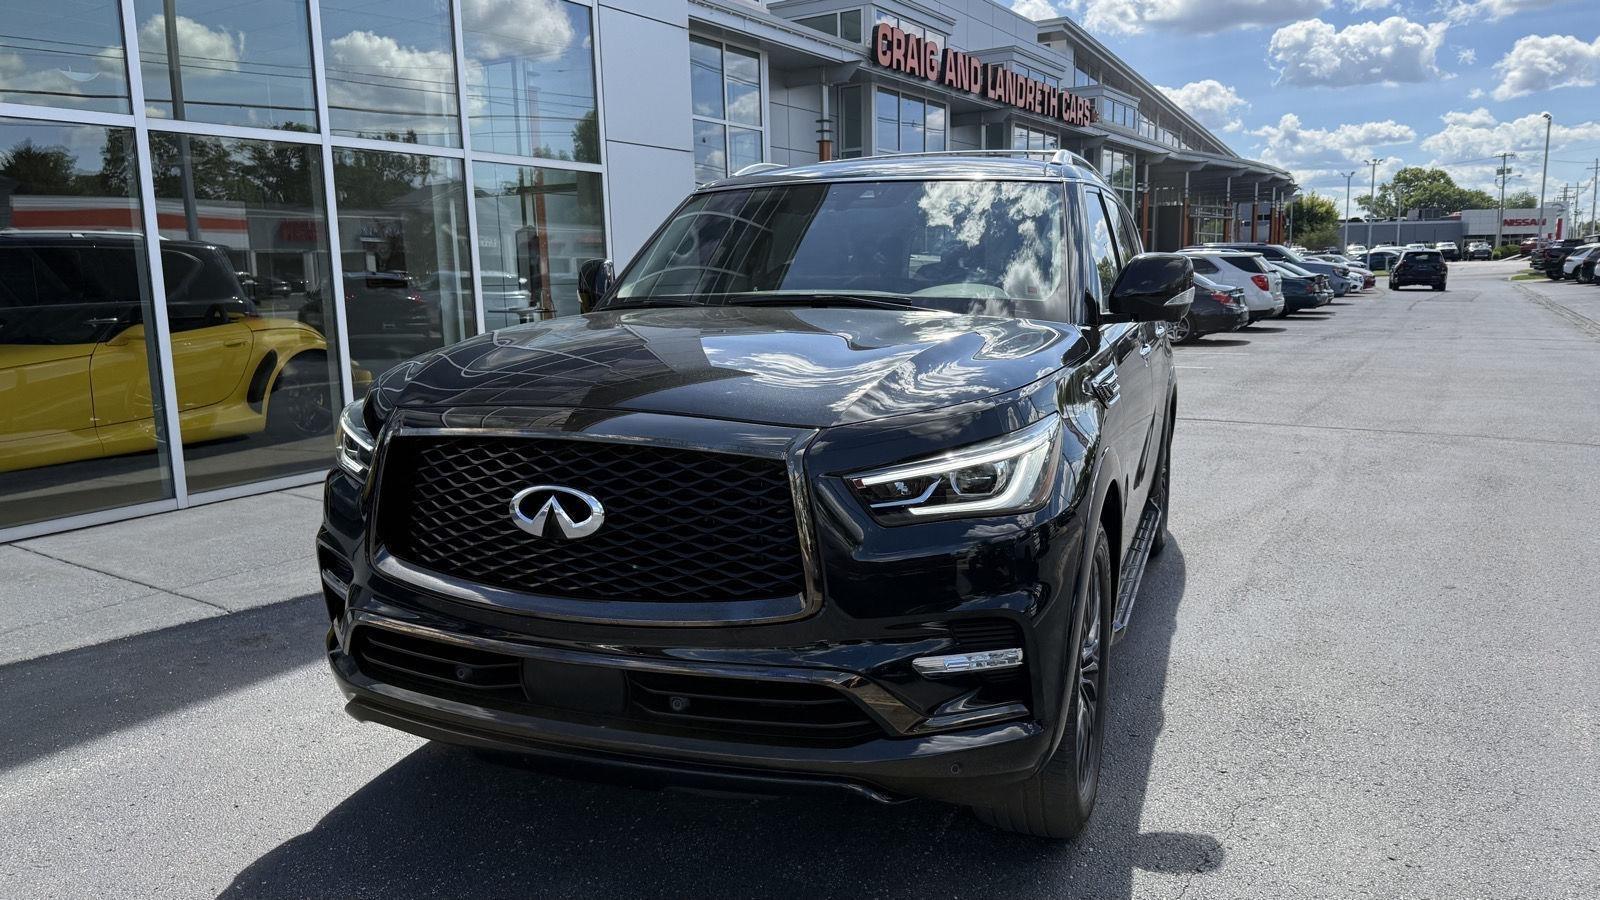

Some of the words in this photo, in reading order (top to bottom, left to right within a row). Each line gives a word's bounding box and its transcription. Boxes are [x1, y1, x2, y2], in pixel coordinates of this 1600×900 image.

[877, 23, 938, 81] CRAIG
[944, 47, 981, 95] AND
[987, 63, 1058, 118] LANDRETH
[1062, 90, 1090, 127] CARS
[1503, 218, 1547, 227] NISSAN
